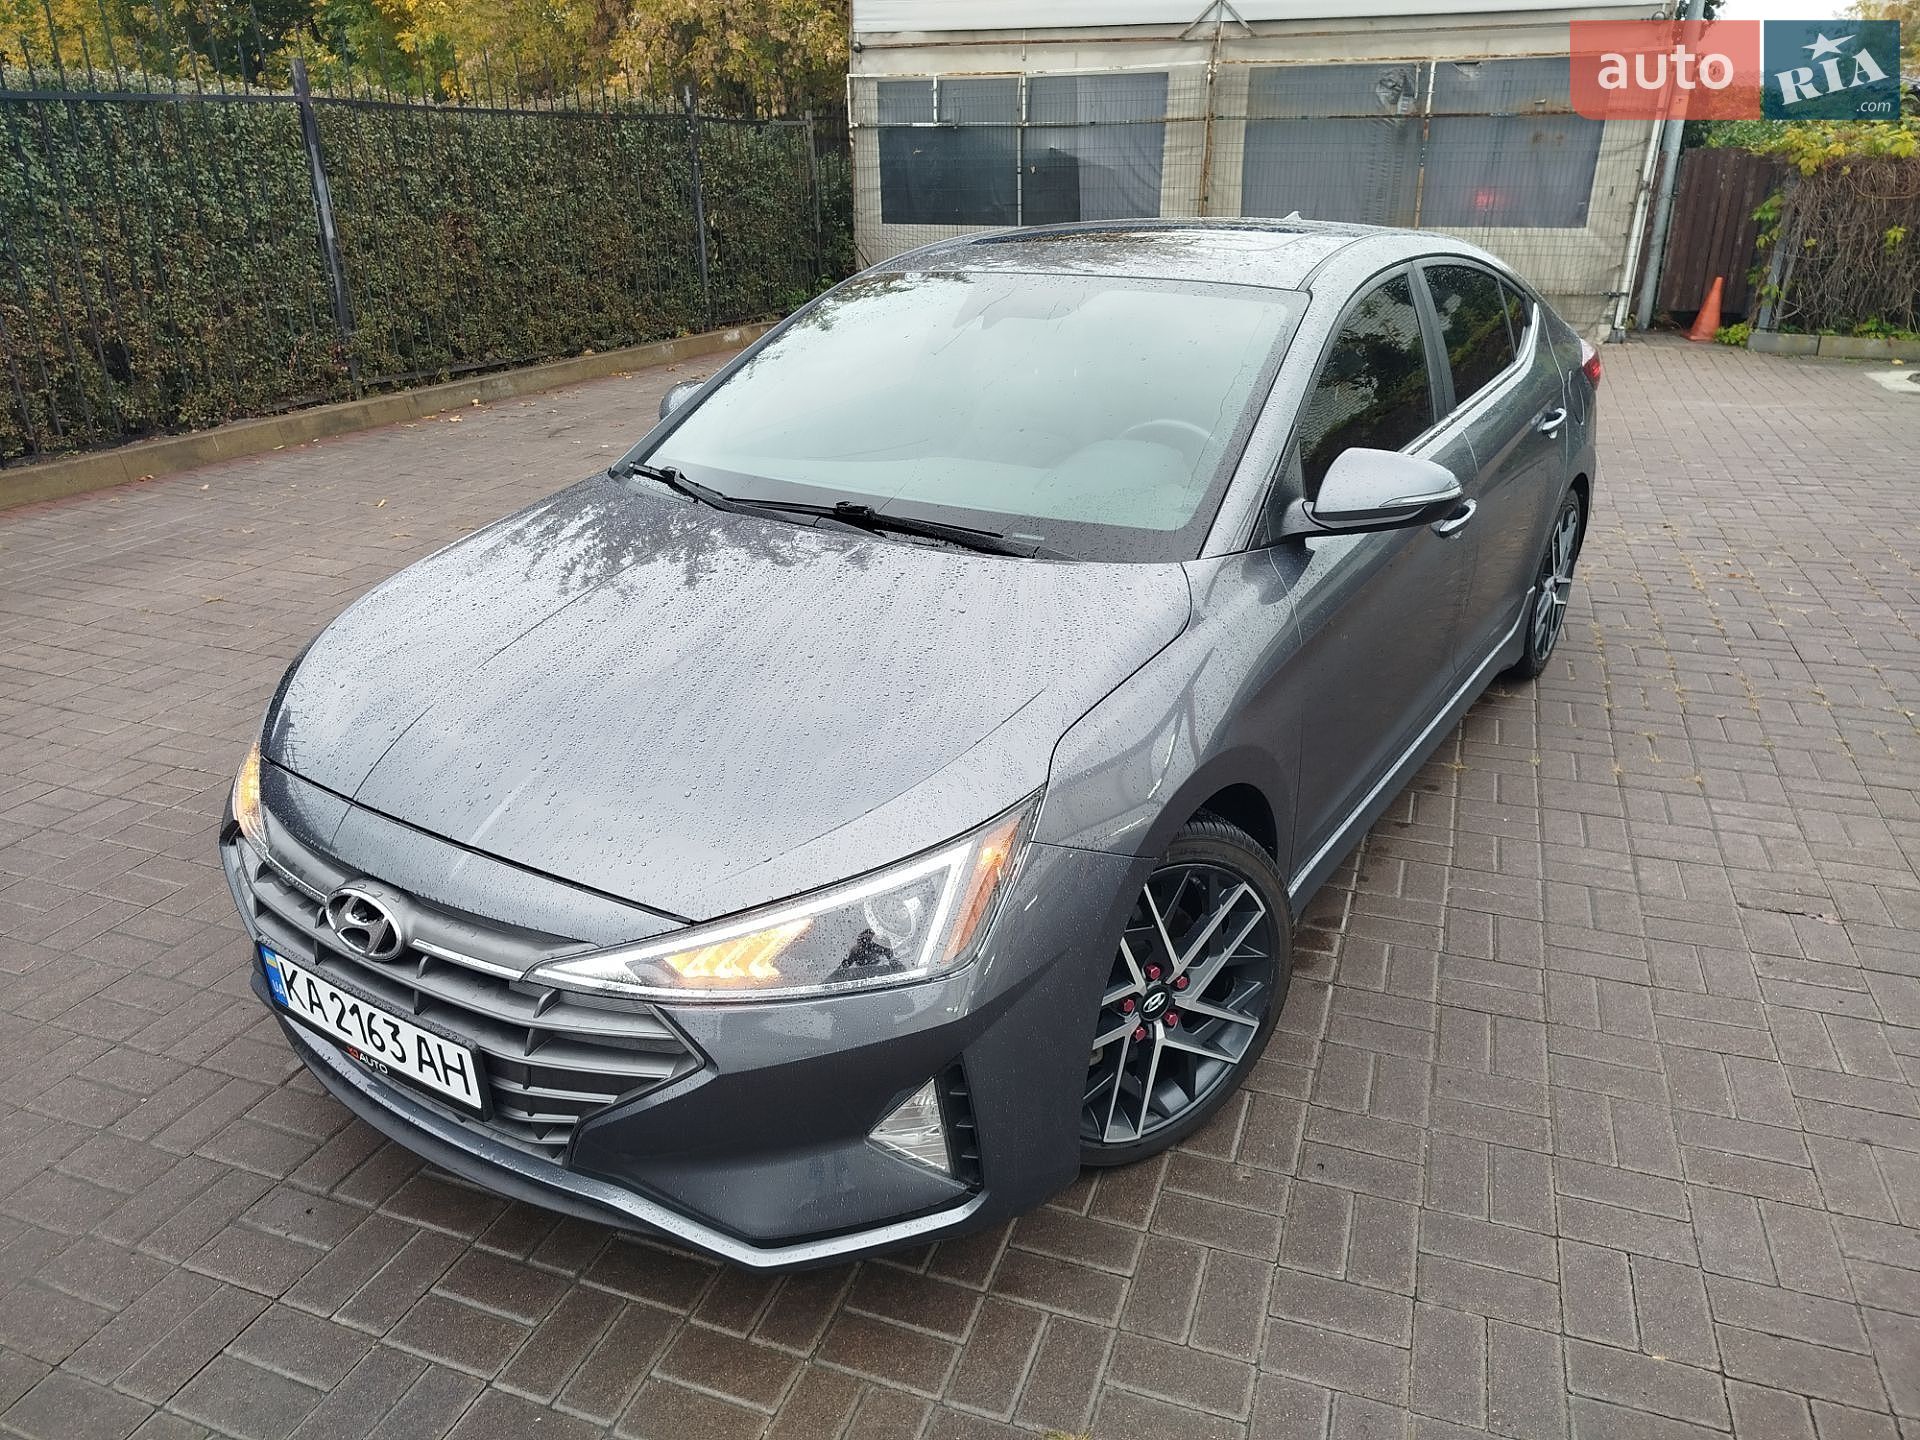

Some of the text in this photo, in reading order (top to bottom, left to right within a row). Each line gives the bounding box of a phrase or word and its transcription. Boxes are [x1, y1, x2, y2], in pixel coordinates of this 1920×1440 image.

[279, 961, 471, 1096] KA 2163 AH
